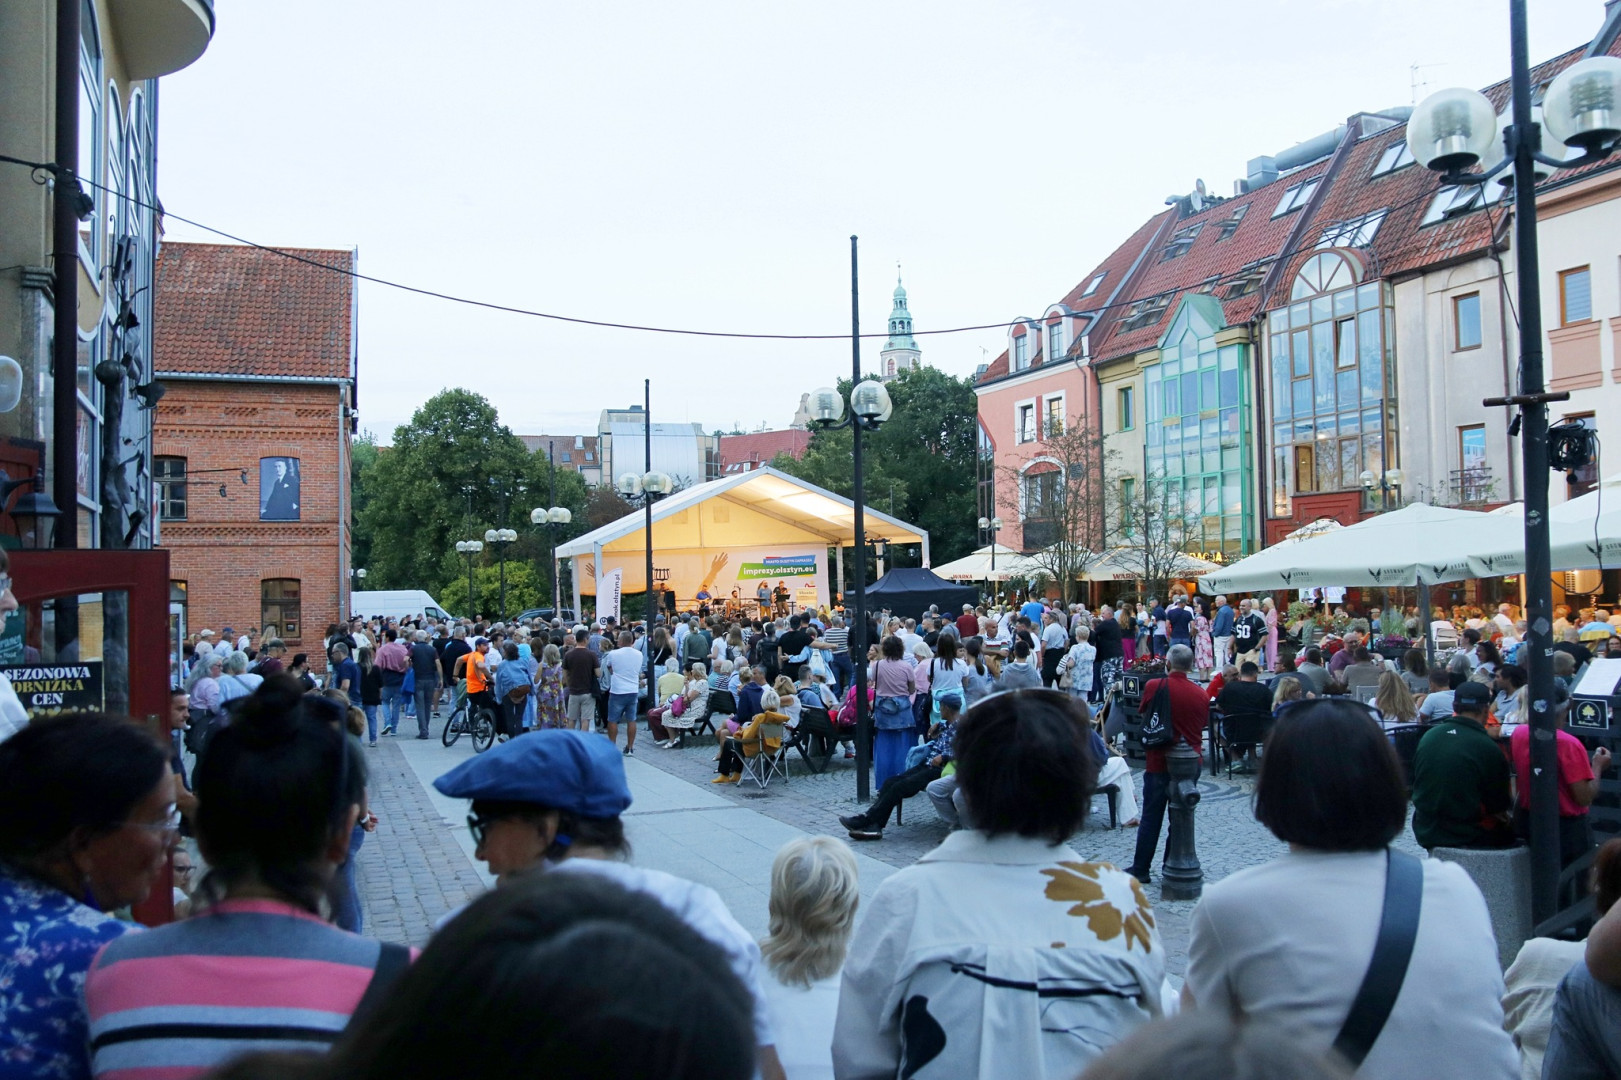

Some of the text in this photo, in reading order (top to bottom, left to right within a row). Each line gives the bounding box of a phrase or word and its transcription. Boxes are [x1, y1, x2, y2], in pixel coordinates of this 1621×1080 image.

[743, 566, 814, 576] imprezy.olsztyn.eu
[1236, 624, 1251, 639] 50
[3, 667, 91, 680] SEZONOWA
[32, 693, 64, 705] CEN
